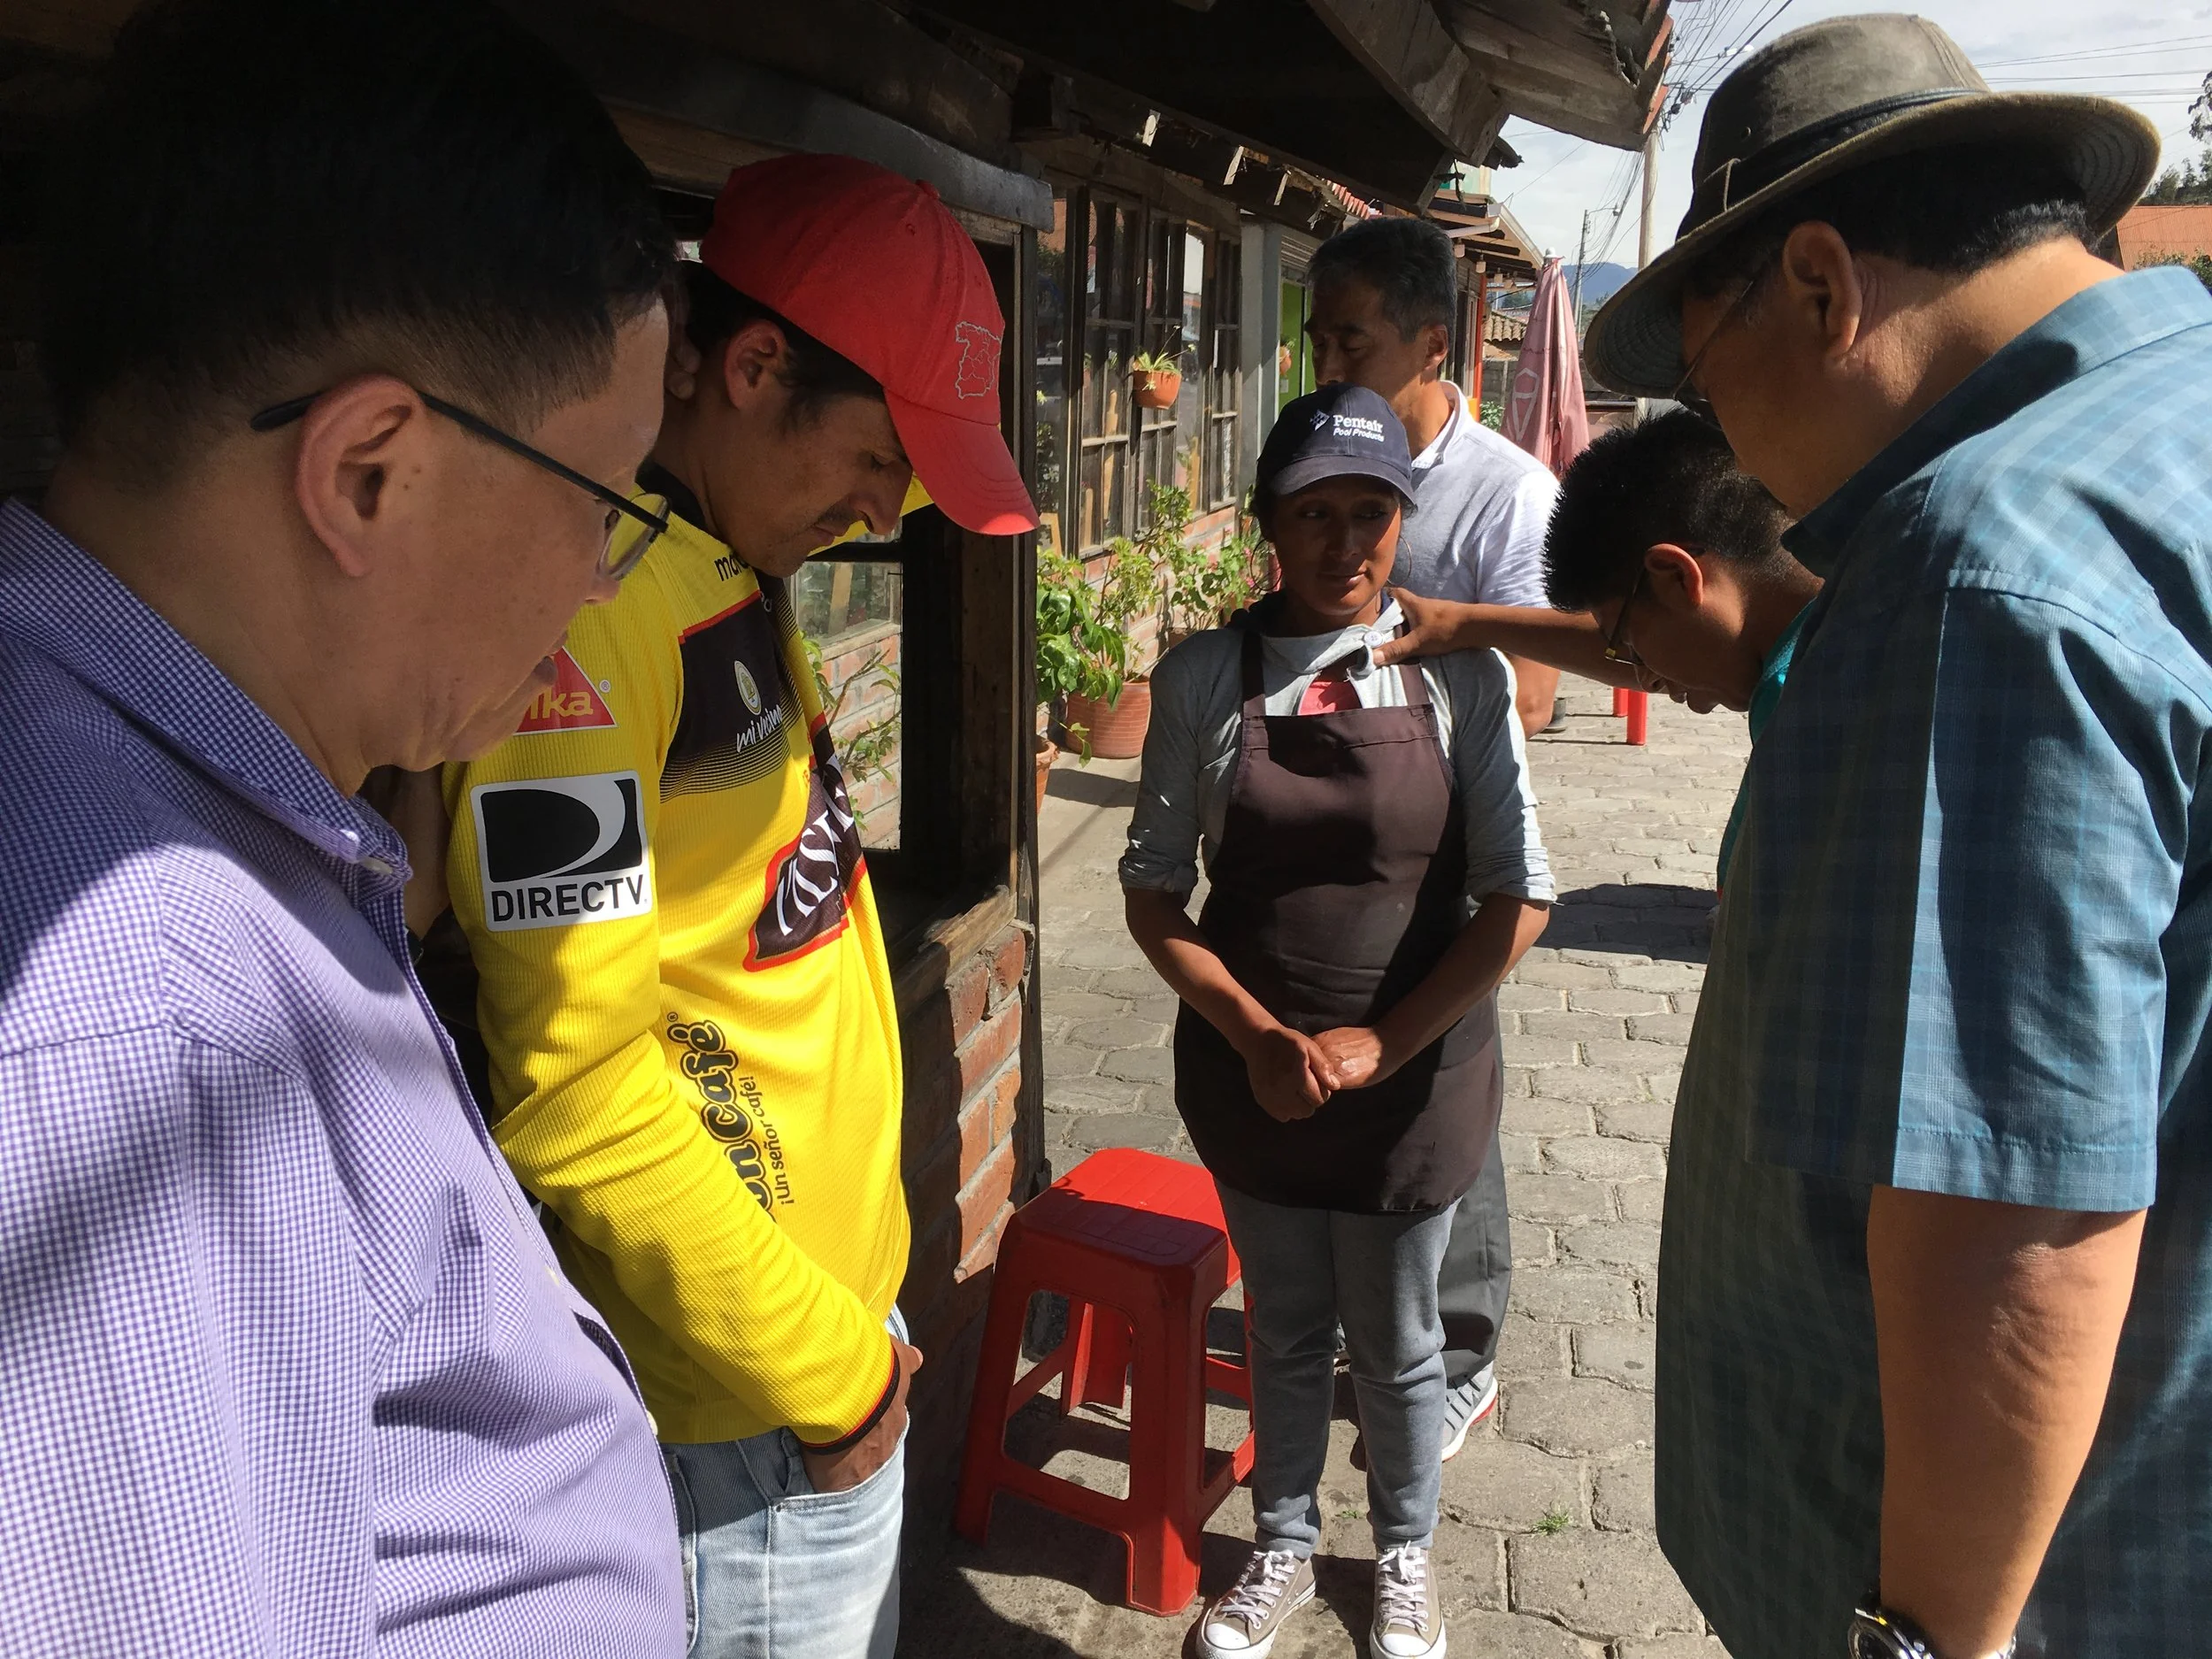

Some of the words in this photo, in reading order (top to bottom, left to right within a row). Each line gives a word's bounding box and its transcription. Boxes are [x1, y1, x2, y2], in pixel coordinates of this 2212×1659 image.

[1333, 414, 1384, 434] Pentair
[1333, 426, 1353, 436] Pool
[1352, 428, 1385, 442] Products
[736, 720, 757, 753] mi
[491, 874, 643, 922] DIRECTV
[739, 1076, 764, 1118] café!
[760, 1119, 784, 1170] señor
[774, 1172, 795, 1204] ¡Un
